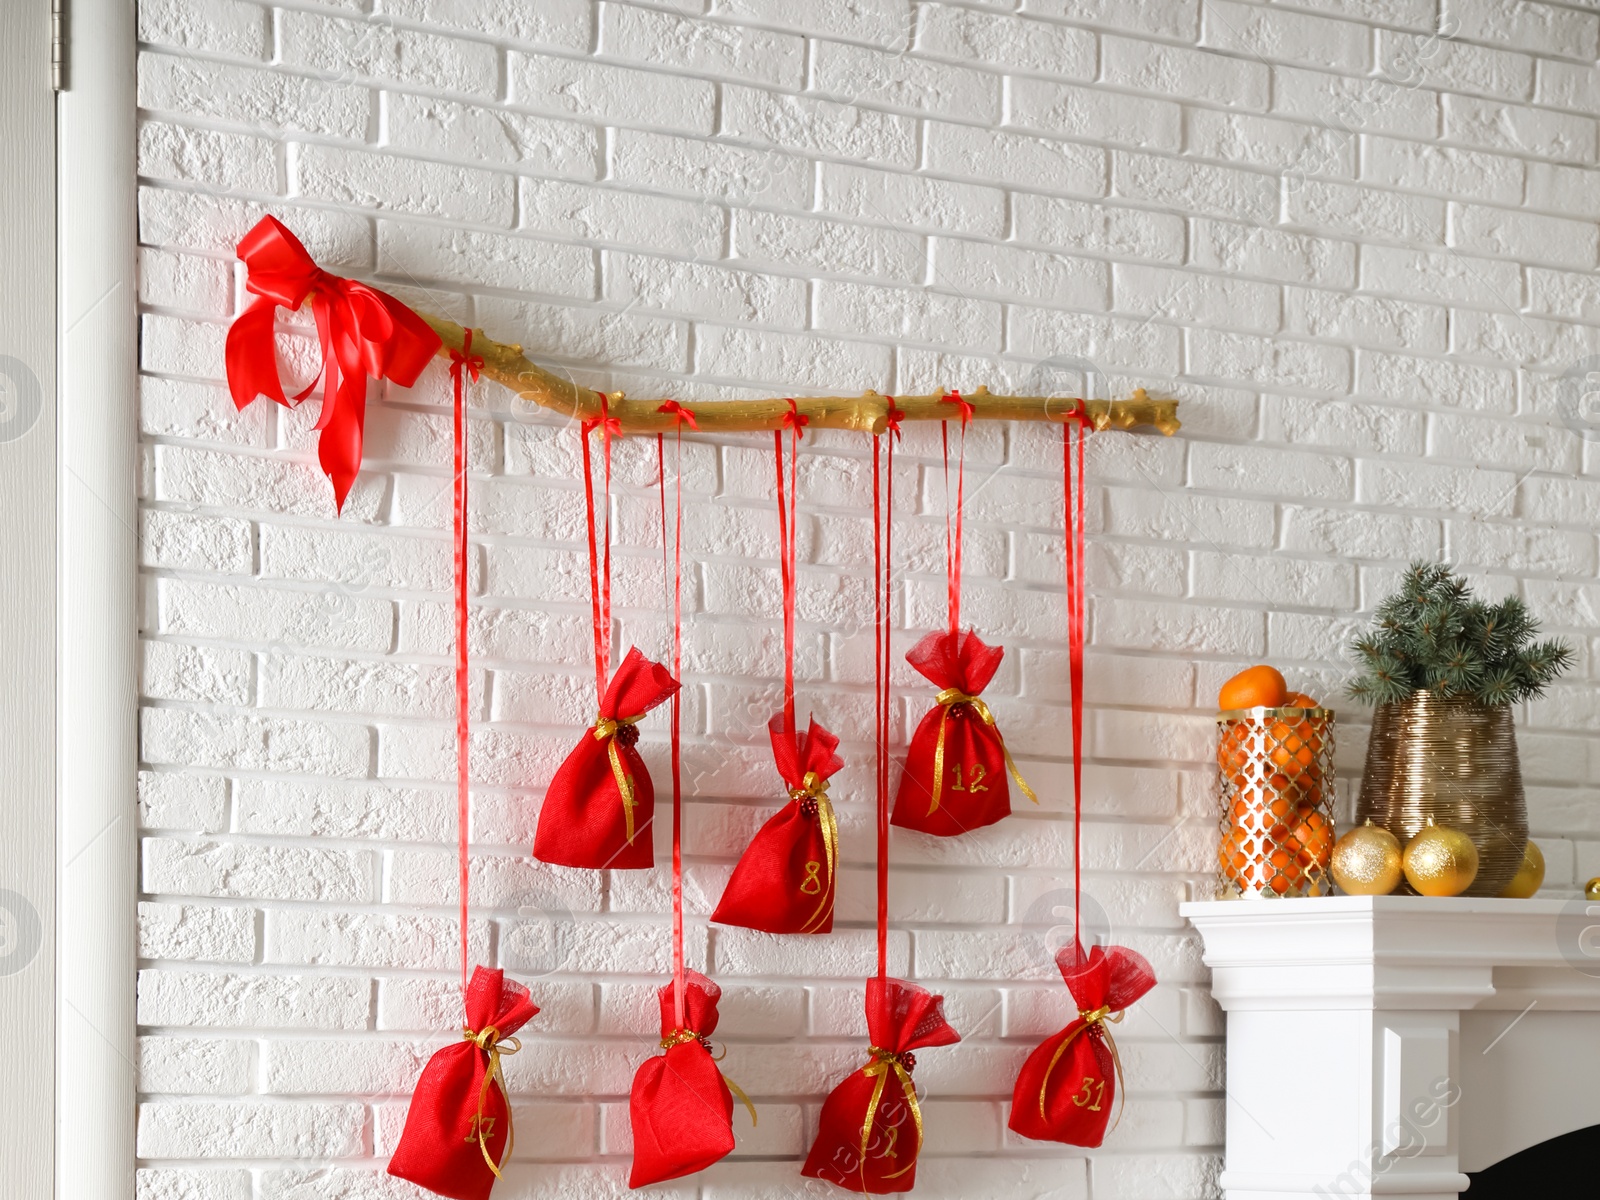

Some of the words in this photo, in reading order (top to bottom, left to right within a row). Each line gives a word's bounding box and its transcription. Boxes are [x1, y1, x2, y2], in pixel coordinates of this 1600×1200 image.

[951, 763, 989, 793] 12
[800, 860, 820, 895] 8
[1072, 1077, 1105, 1111] 31
[464, 1114, 496, 1143] 17
